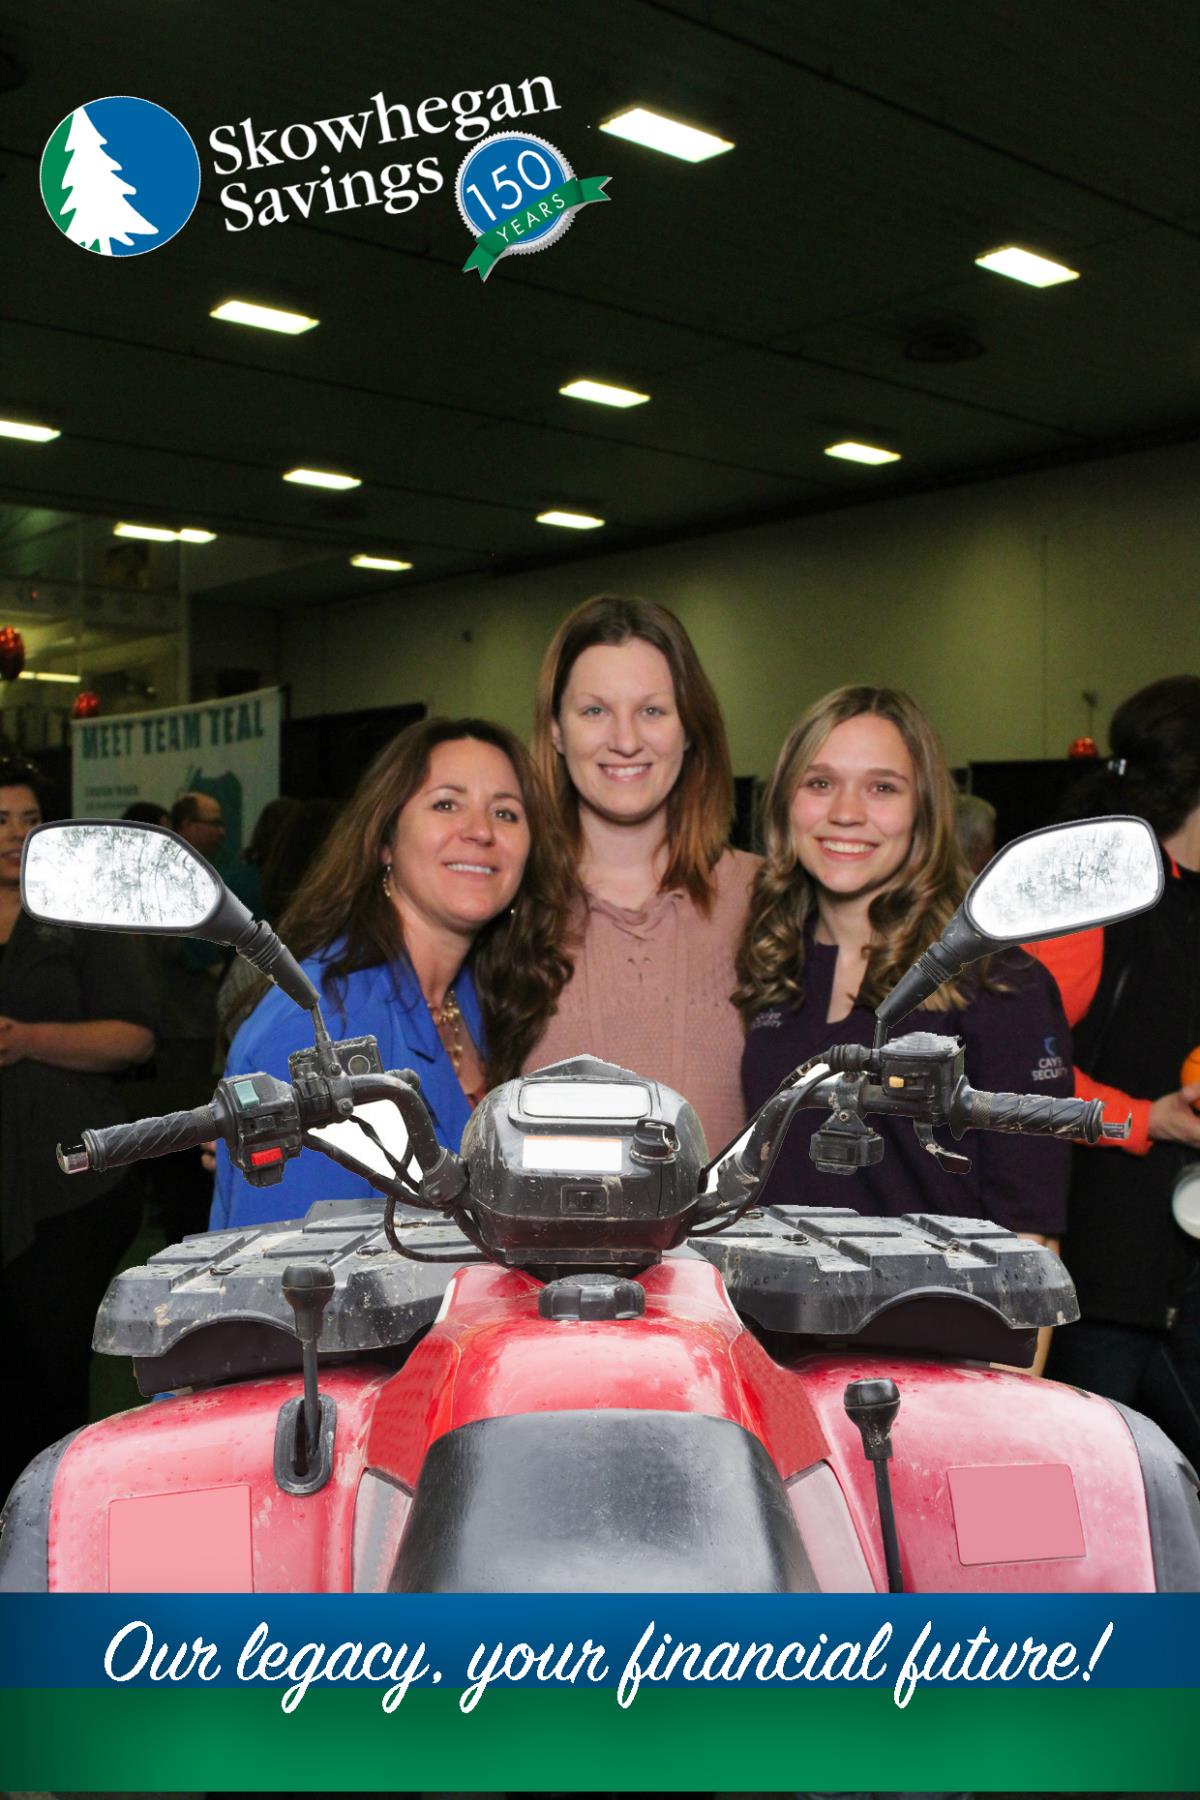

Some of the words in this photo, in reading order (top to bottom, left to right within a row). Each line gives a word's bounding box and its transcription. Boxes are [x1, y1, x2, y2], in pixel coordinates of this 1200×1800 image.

[81, 721, 134, 759] MEET
[142, 712, 202, 754] TEAM
[208, 700, 264, 745] TEAL
